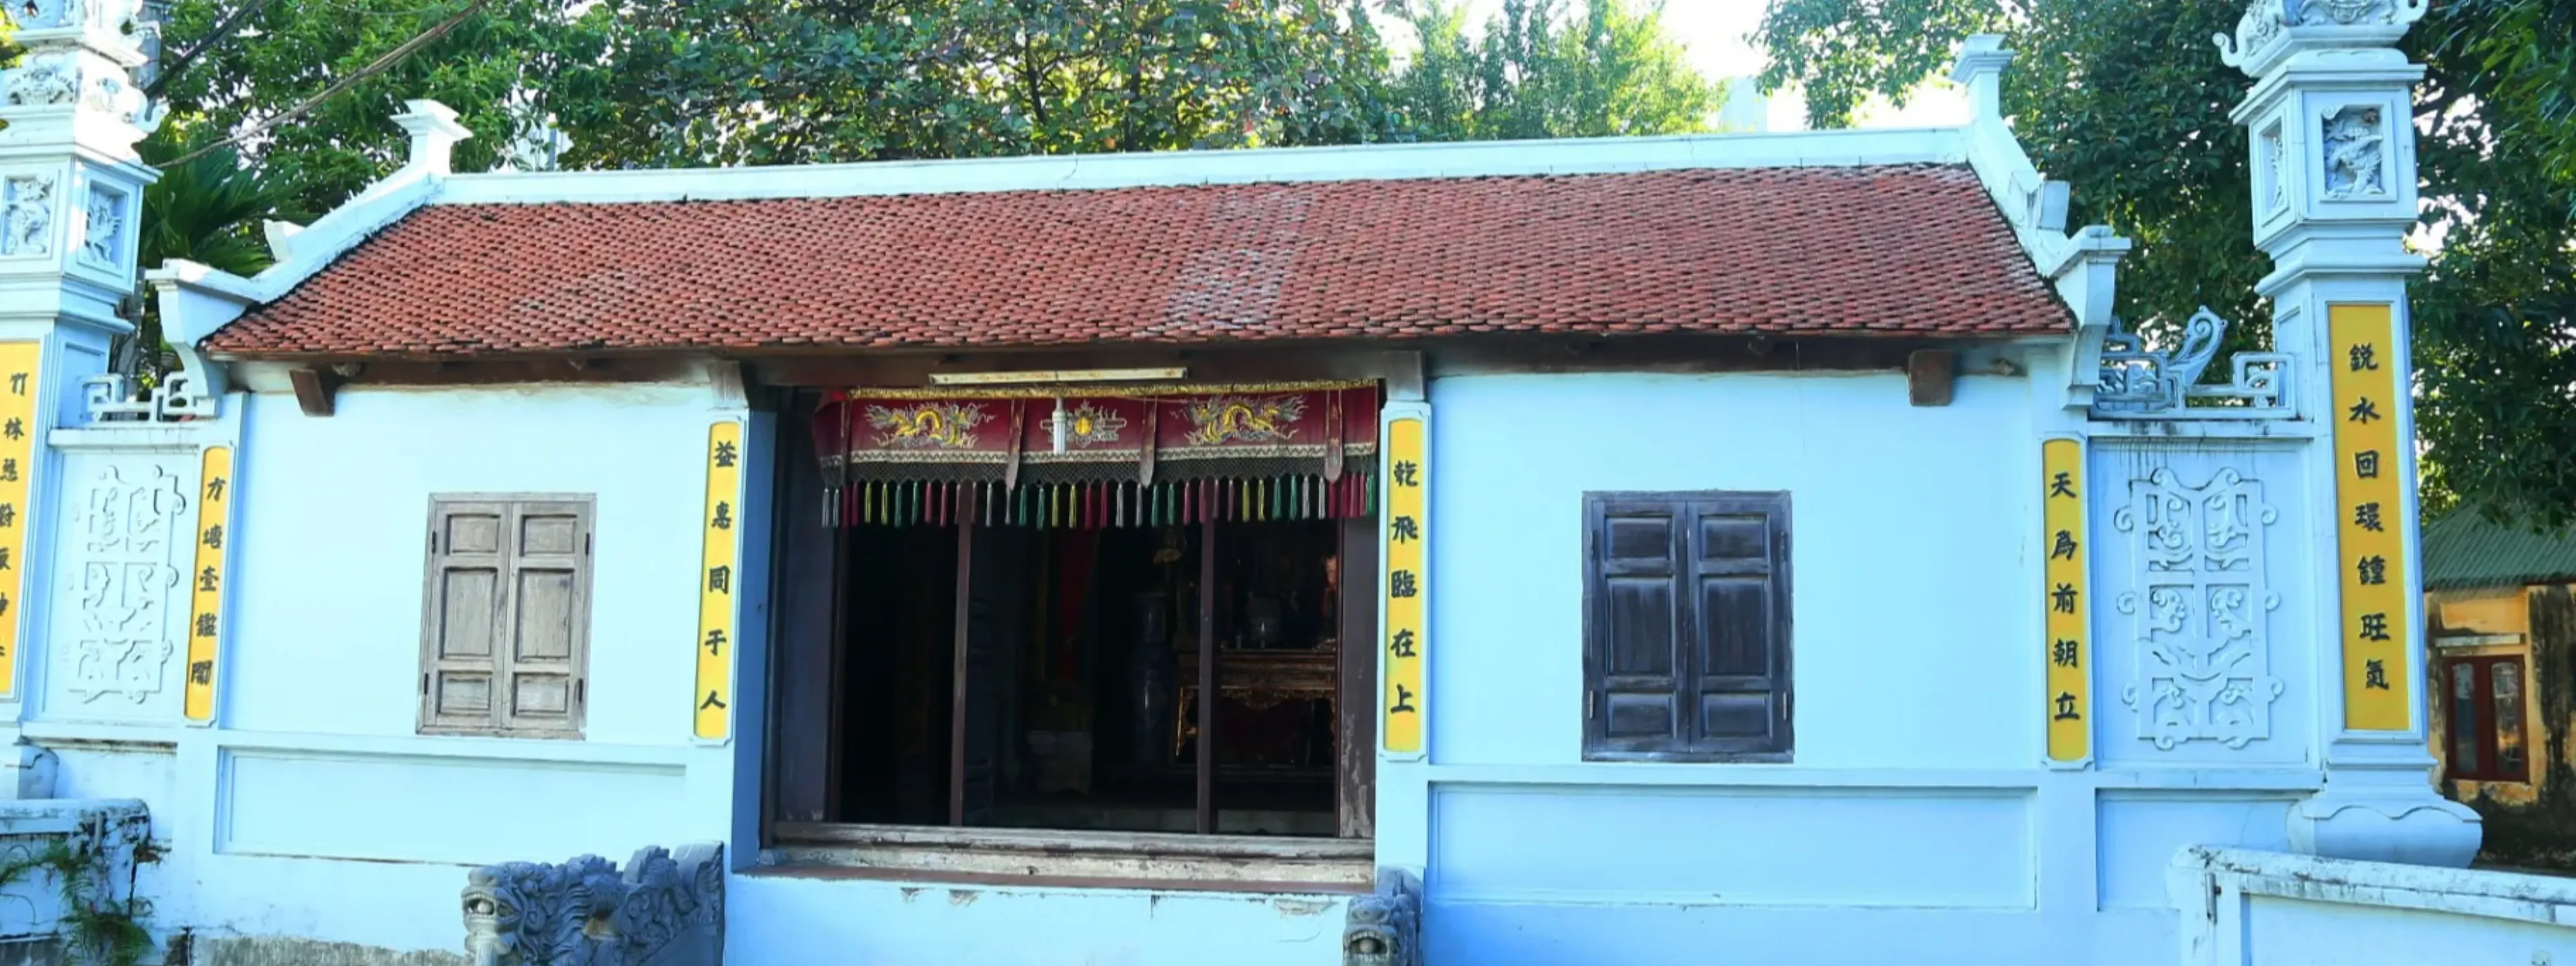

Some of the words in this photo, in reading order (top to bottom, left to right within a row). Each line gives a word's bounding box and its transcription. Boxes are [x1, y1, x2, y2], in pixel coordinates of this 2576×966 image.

[1390, 460, 1418, 714] 乾飛臨在上
